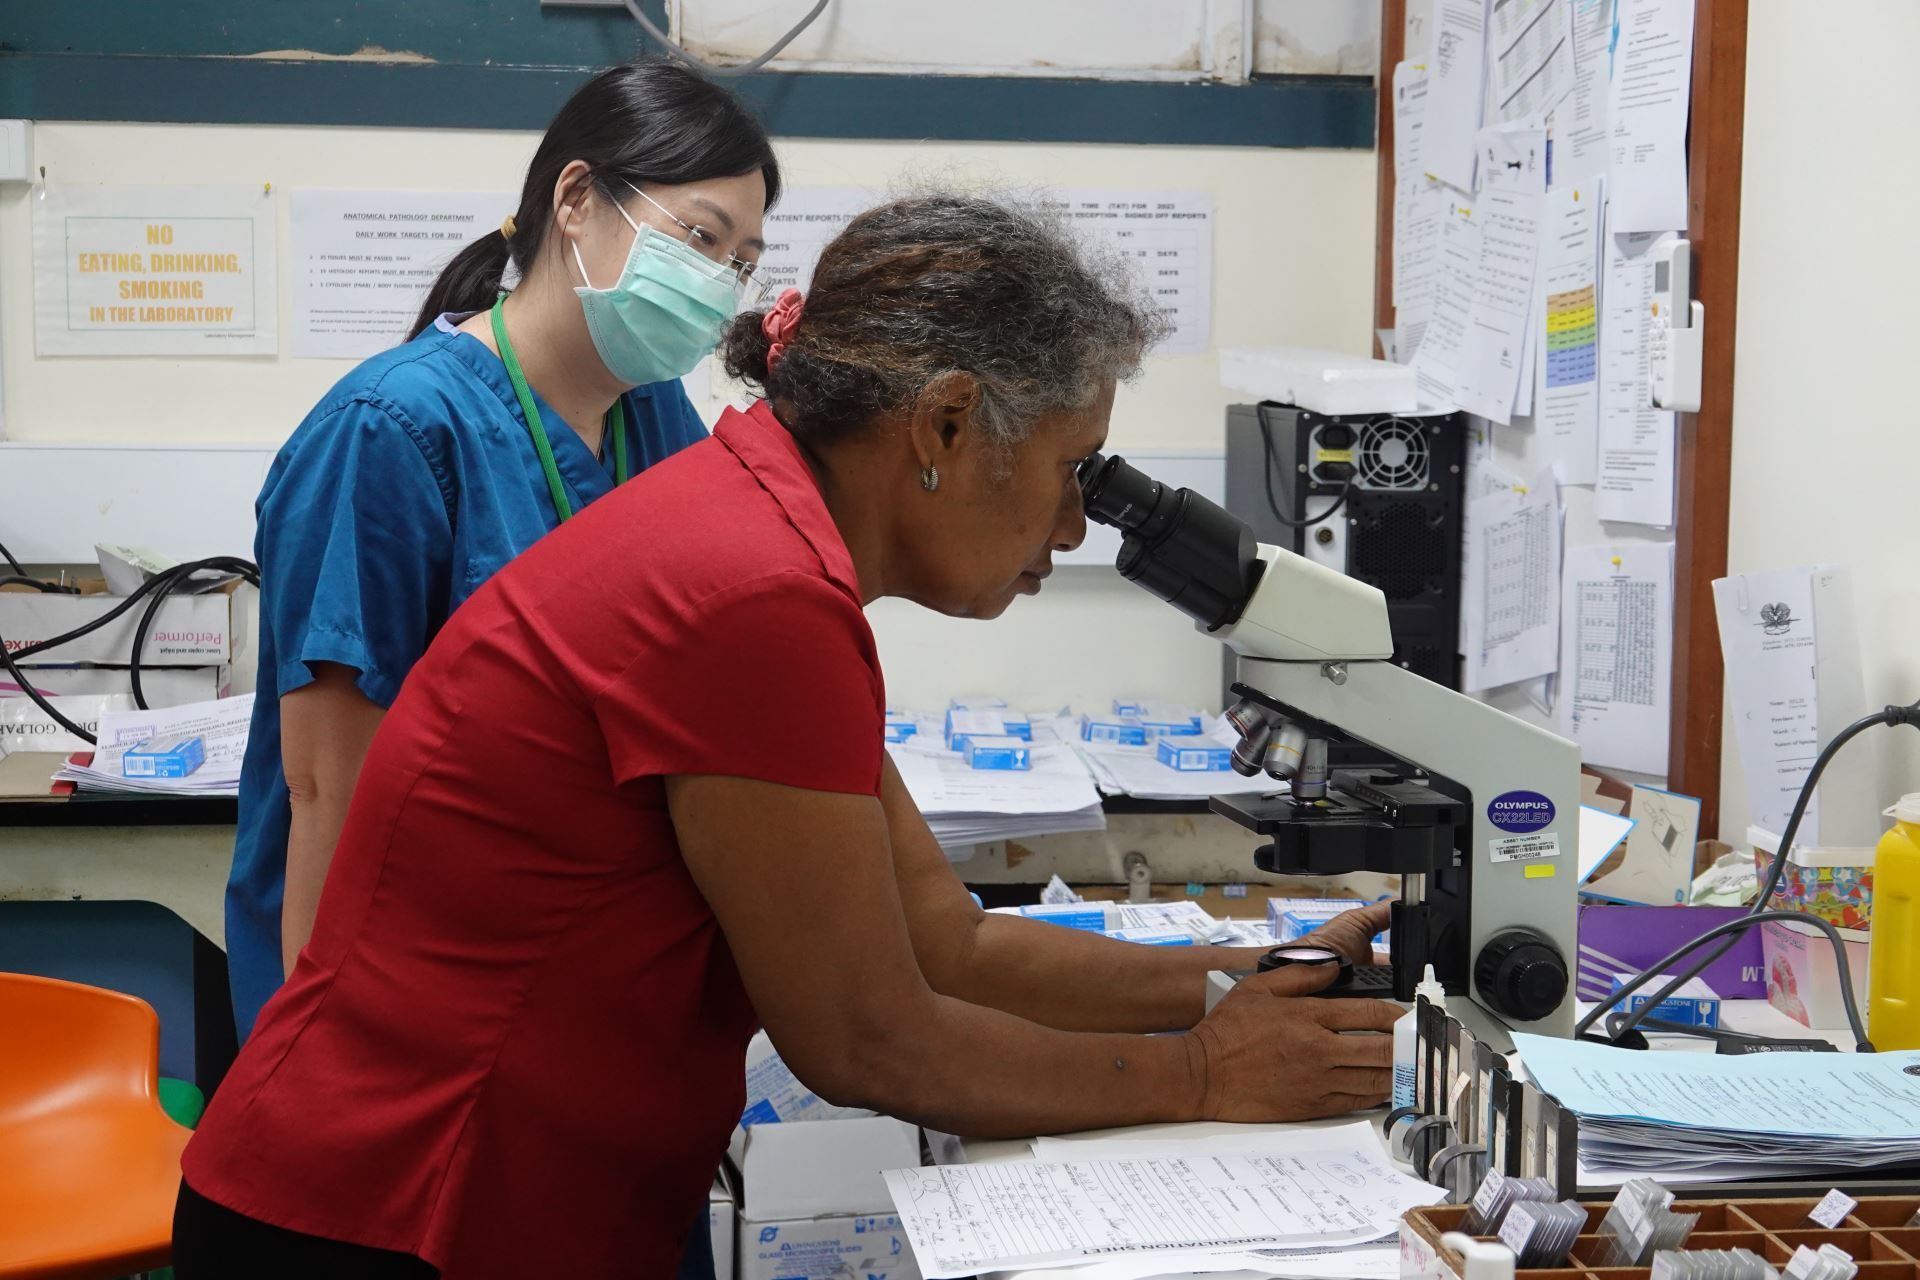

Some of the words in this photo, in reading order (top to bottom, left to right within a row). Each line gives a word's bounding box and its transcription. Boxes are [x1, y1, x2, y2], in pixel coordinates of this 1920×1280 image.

[343, 212, 386, 220] ANATOMICAL
[389, 213, 428, 222] PATHOLOGY
[431, 214, 475, 222] DEPARTMENT
[147, 224, 173, 246] NO
[355, 230, 374, 239] DAILY
[376, 231, 398, 239] WORK
[78, 253, 147, 274] EATING,
[150, 254, 243, 274] DRINKING,
[119, 280, 204, 300] SMOKING
[89, 306, 106, 322] IN
[108, 306, 136, 322] THE
[139, 306, 234, 322] LABORATORY
[154, 631, 222, 645] Performer
[1492, 812, 1550, 824] CX22LED
[1081, 1245, 1136, 1256] SHEET
[1142, 1236, 1278, 1251] CONSULTATION
[759, 1251, 784, 1259] GLASS
[785, 1248, 835, 1258] MICROSCOPE
[837, 1246, 862, 1254] SLIDES
